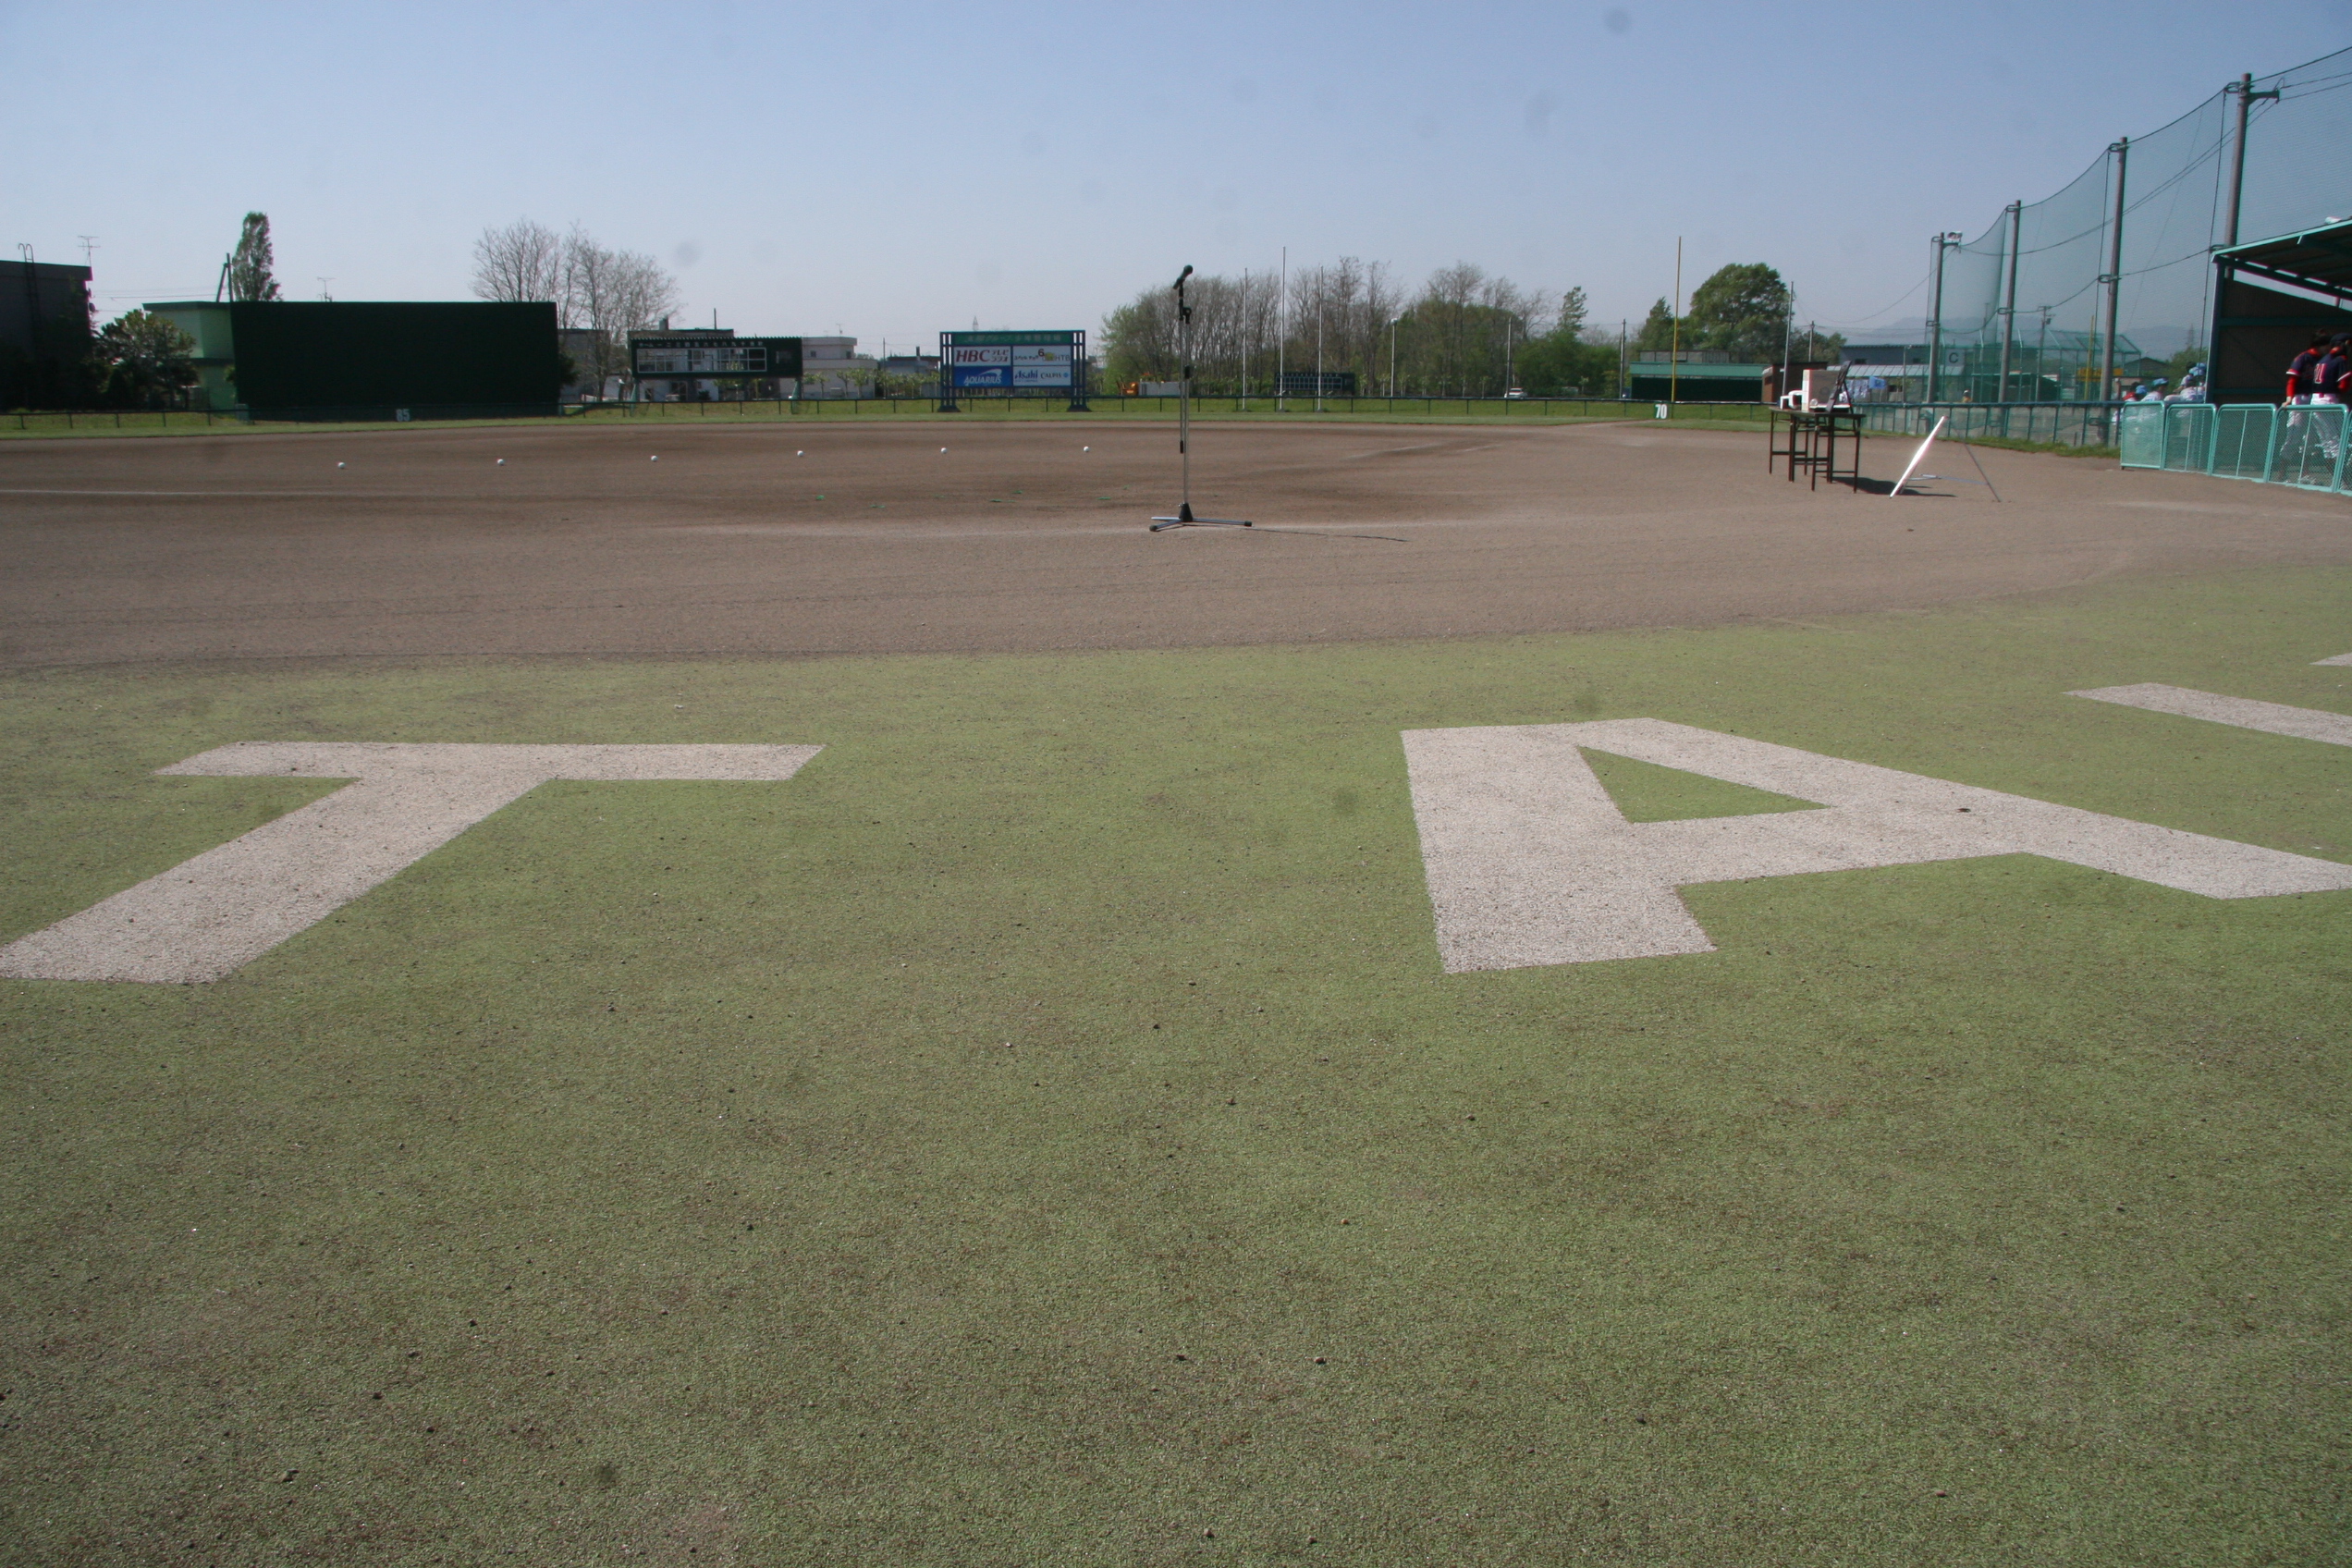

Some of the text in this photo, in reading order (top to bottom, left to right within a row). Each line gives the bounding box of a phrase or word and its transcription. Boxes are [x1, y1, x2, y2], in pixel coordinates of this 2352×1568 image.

[956, 349, 990, 362] HBC
[963, 374, 1002, 386] AQUARIUS
[1014, 370, 1037, 379] Asahi
[396, 408, 410, 422] 85
[1655, 403, 1668, 419] 70
